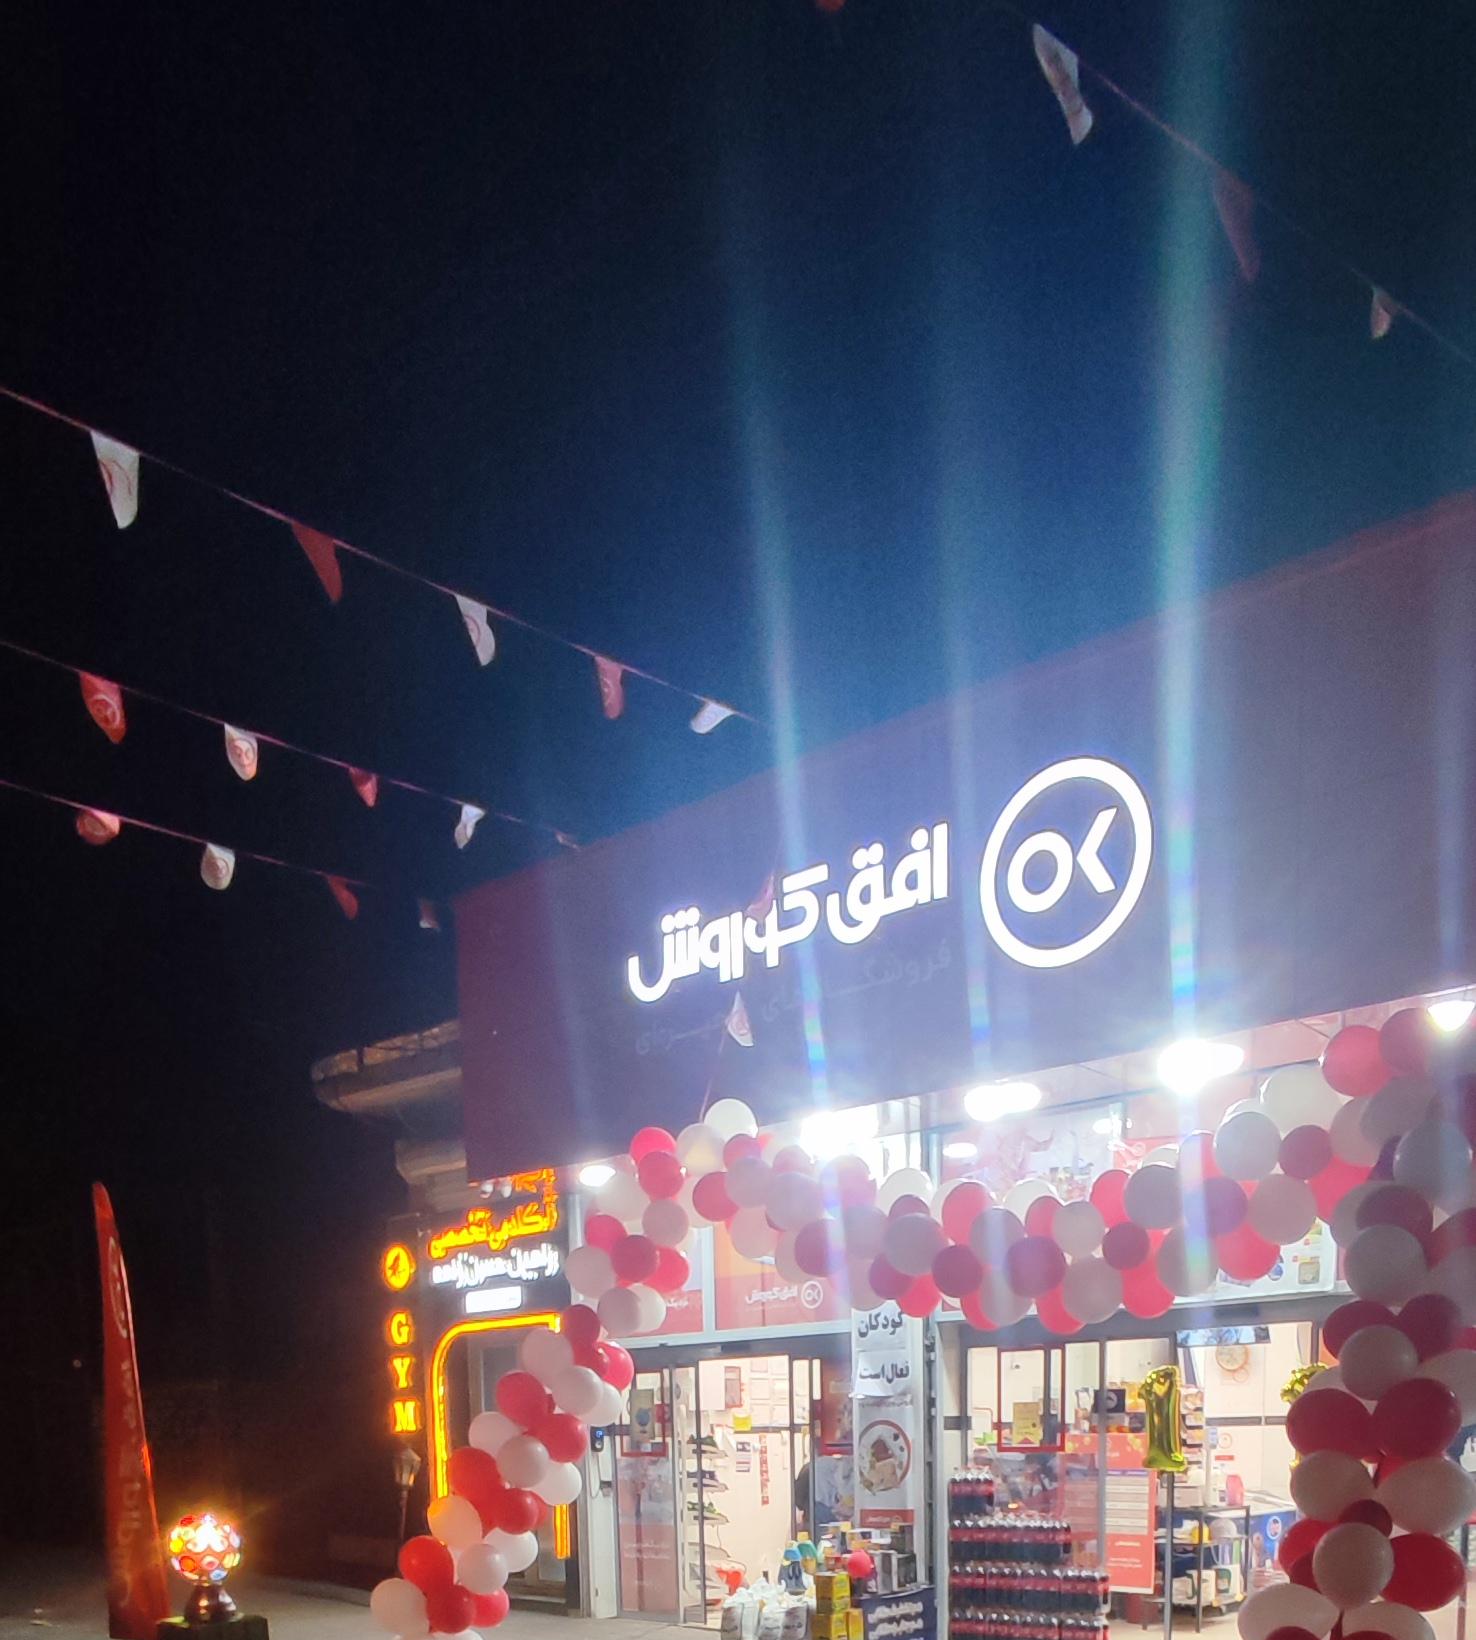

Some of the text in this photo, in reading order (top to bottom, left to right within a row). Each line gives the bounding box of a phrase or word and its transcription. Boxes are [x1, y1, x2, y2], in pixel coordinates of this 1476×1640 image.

[626, 822, 949, 1004] افق کوروش
[1007, 806, 1118, 913] OK
[390, 1312, 417, 1433] GYM
[859, 1361, 910, 1384] فعال است
